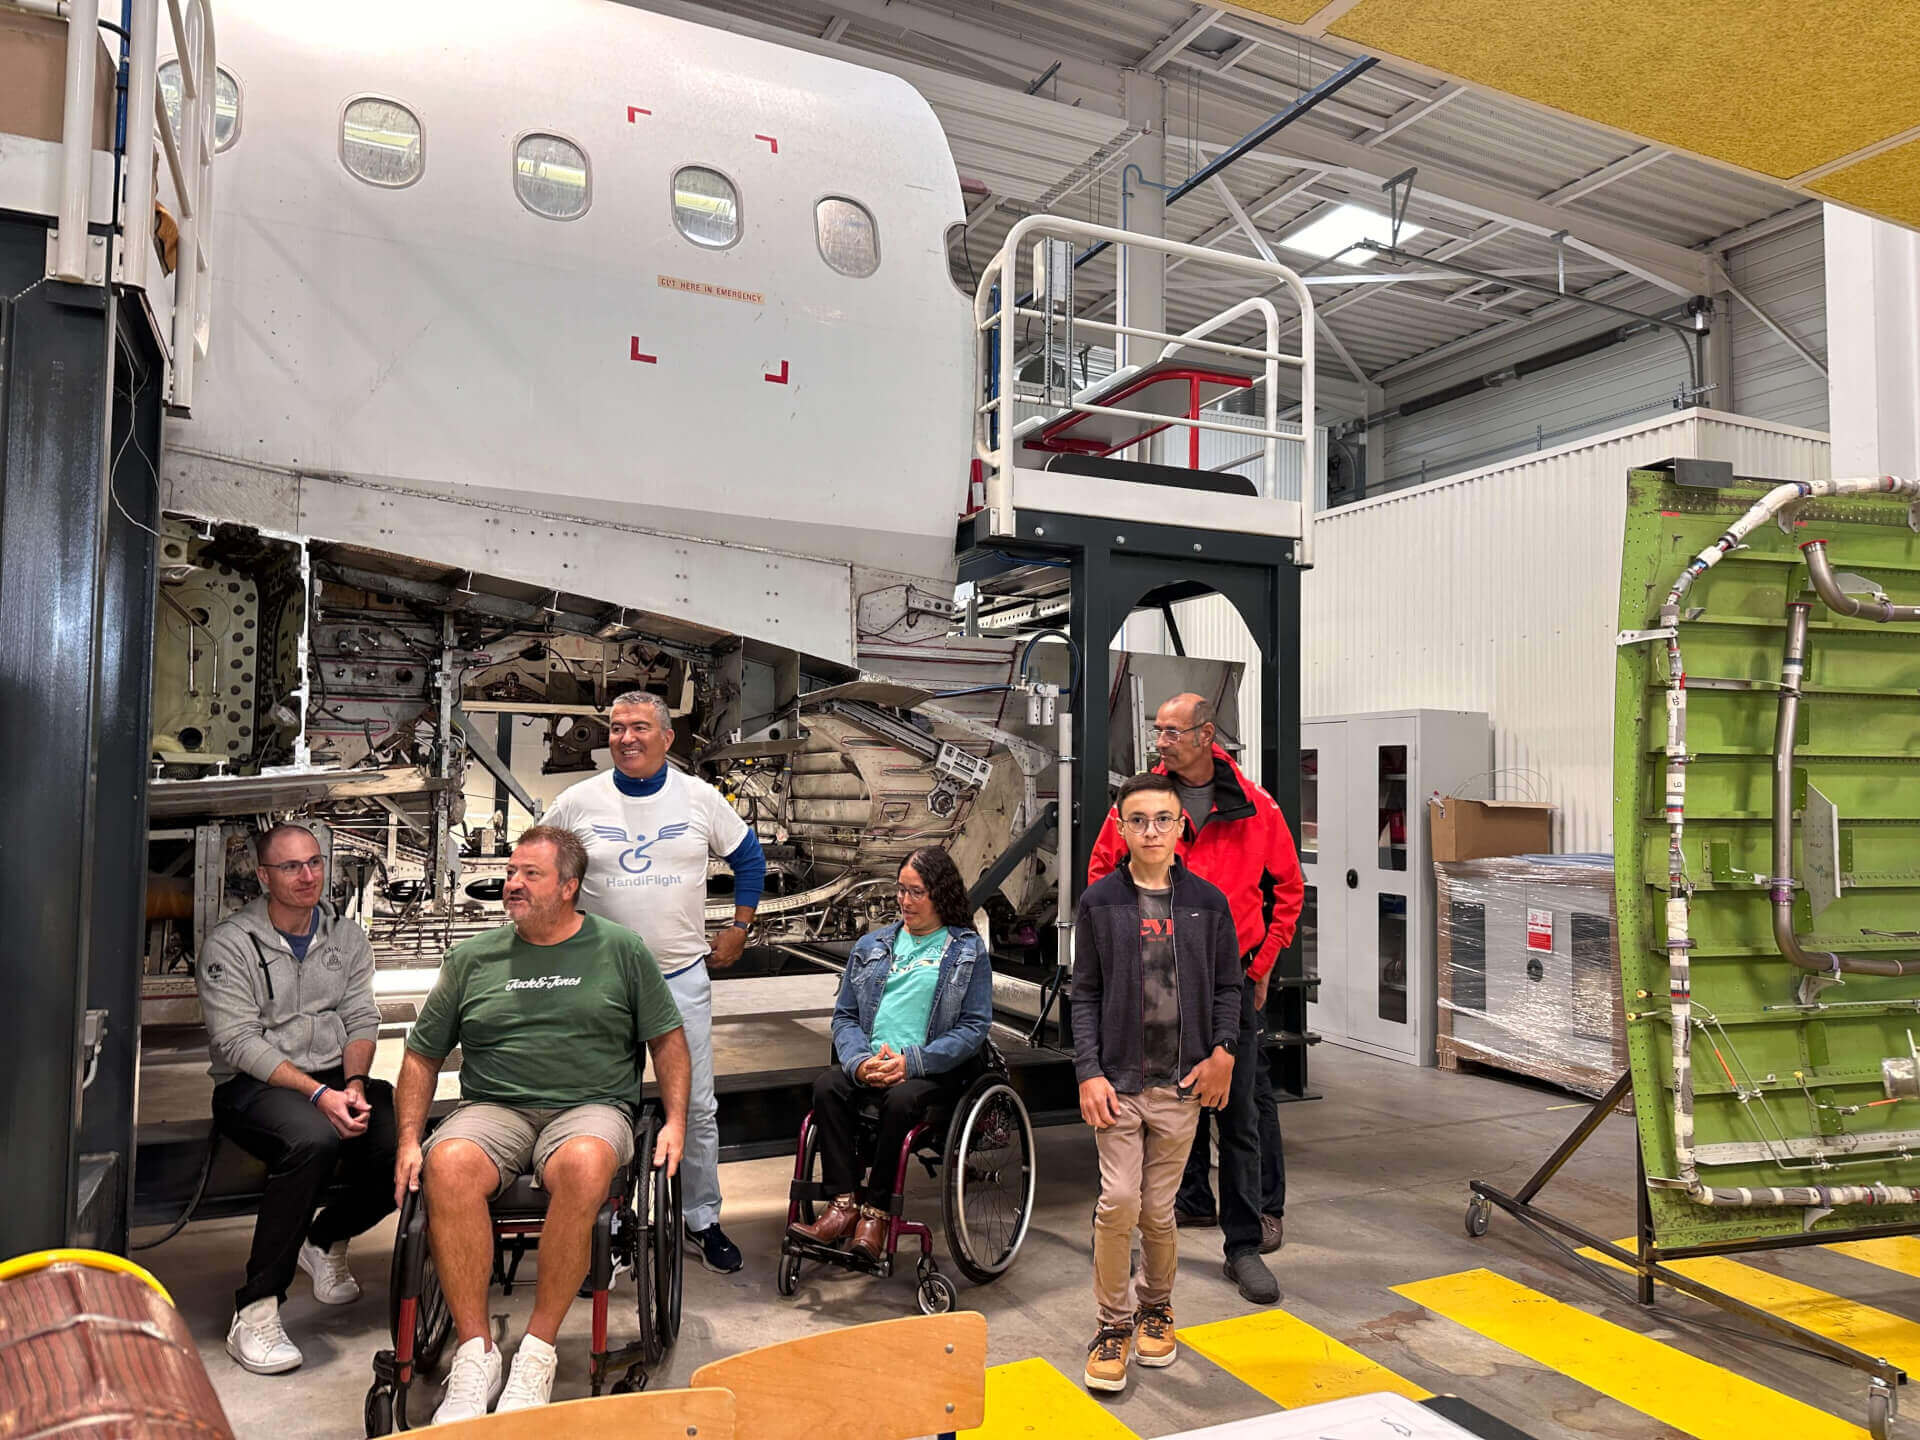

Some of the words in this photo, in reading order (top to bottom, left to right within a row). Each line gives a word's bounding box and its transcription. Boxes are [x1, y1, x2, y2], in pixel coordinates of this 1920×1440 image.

[661, 278, 676, 287] CUT
[680, 282, 700, 292] HERE
[704, 285, 713, 294] IN
[716, 287, 762, 303] EMERGENCY
[606, 874, 682, 888] HandiFlight
